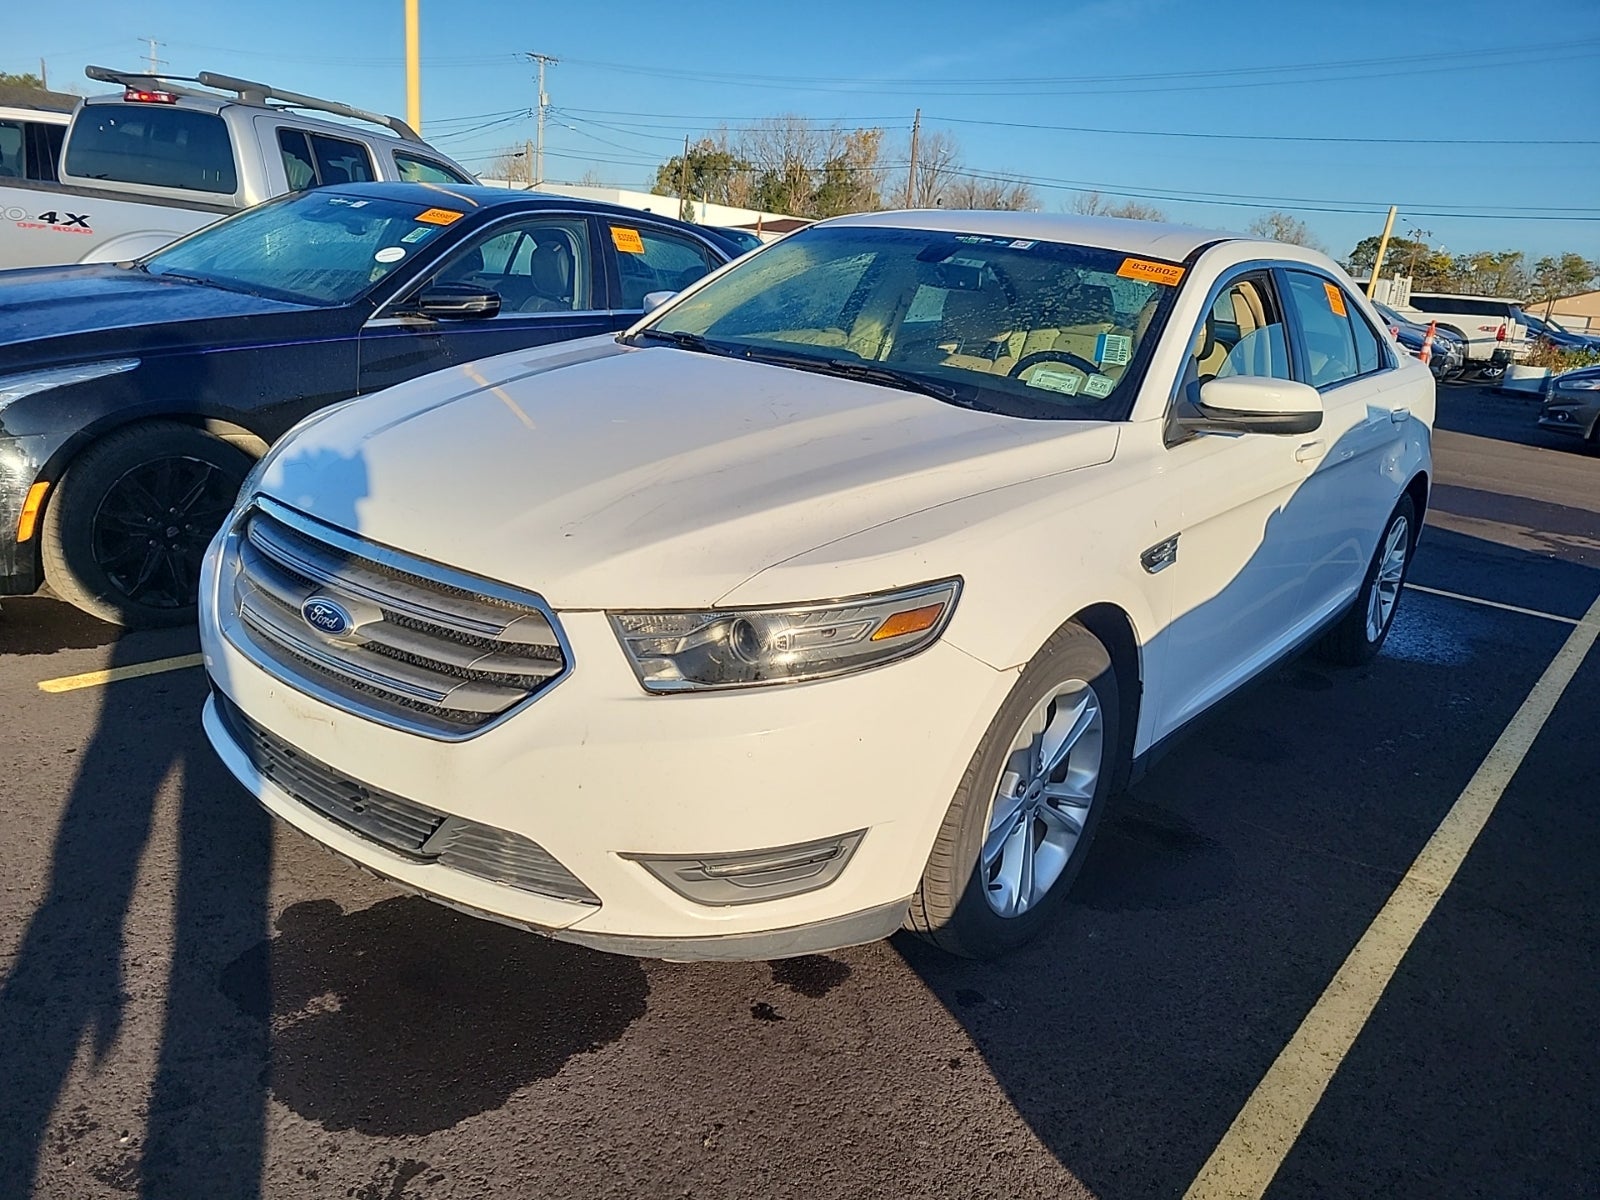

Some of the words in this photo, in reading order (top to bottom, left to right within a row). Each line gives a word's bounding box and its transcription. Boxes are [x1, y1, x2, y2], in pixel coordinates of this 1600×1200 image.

[16, 222, 47, 230] OFF
[51, 225, 94, 235] ROAD
[1132, 263, 1178, 276] 835802
[310, 605, 339, 629] Ford
